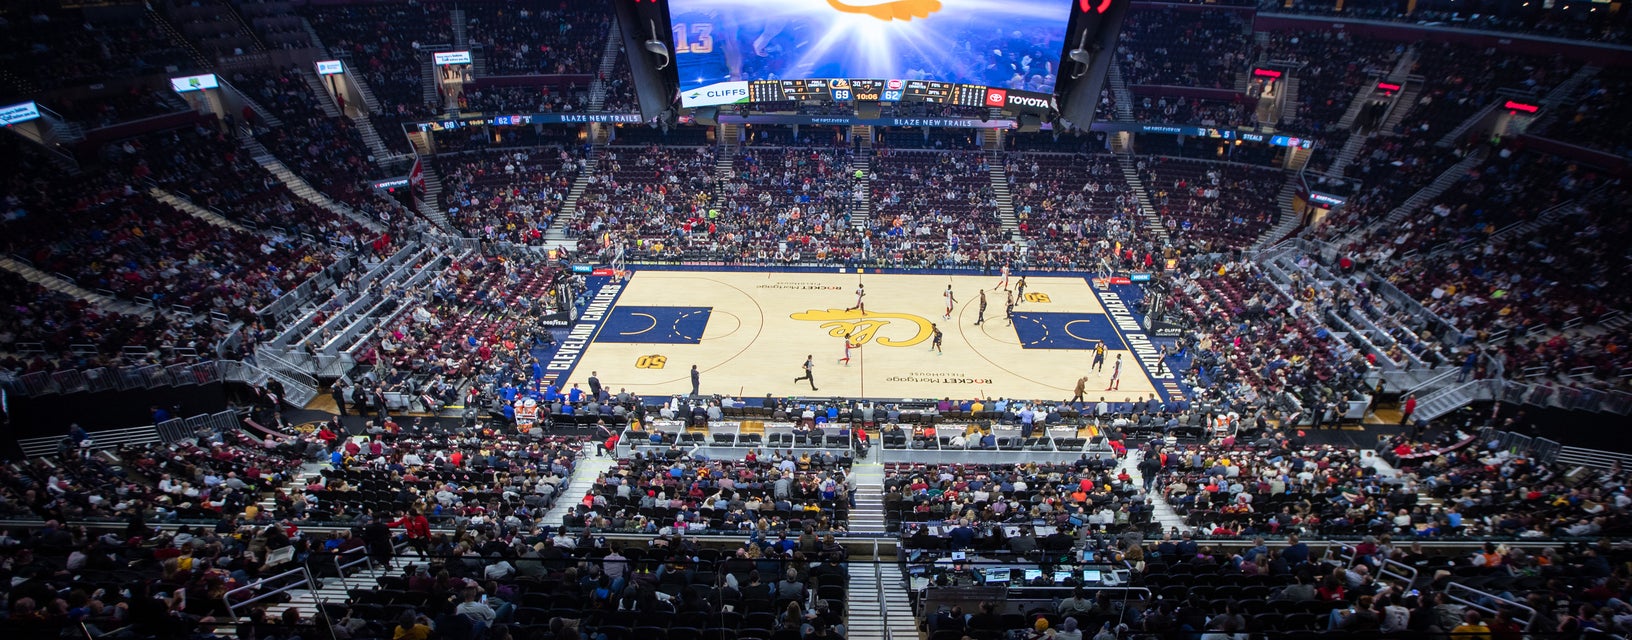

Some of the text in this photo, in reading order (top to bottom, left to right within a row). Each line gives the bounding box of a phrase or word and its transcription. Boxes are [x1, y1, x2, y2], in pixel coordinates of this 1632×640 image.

[672, 23, 713, 53] 13
[707, 88, 746, 98] CLIFFS
[836, 90, 849, 99] 69
[886, 91, 898, 100] 62
[1008, 96, 1049, 108] TOYOTA
[580, 284, 622, 321] CAVALIERS
[1098, 292, 1141, 330] CLEVELAND
[546, 324, 596, 370] CLEVELAND
[1126, 334, 1175, 379] CAVALIERS
